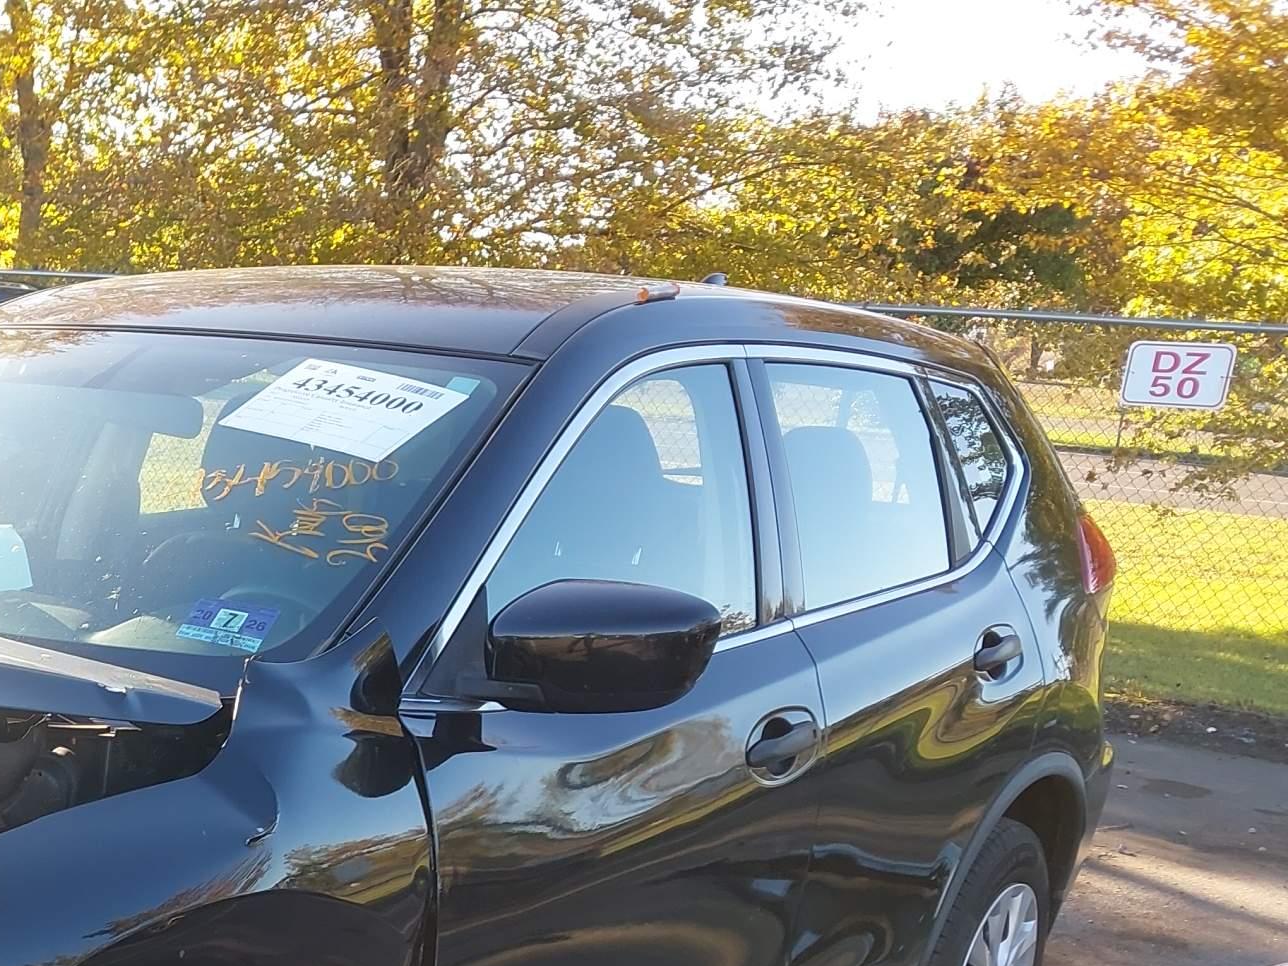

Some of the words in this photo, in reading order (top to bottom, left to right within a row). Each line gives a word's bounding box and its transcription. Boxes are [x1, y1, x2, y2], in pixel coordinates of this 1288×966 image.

[1152, 351, 1211, 375] DZ
[293, 377, 423, 415] 43454000
[1149, 375, 1200, 399] 50
[192, 609, 213, 620] 20
[222, 612, 239, 628] 7
[245, 619, 267, 631] 26
